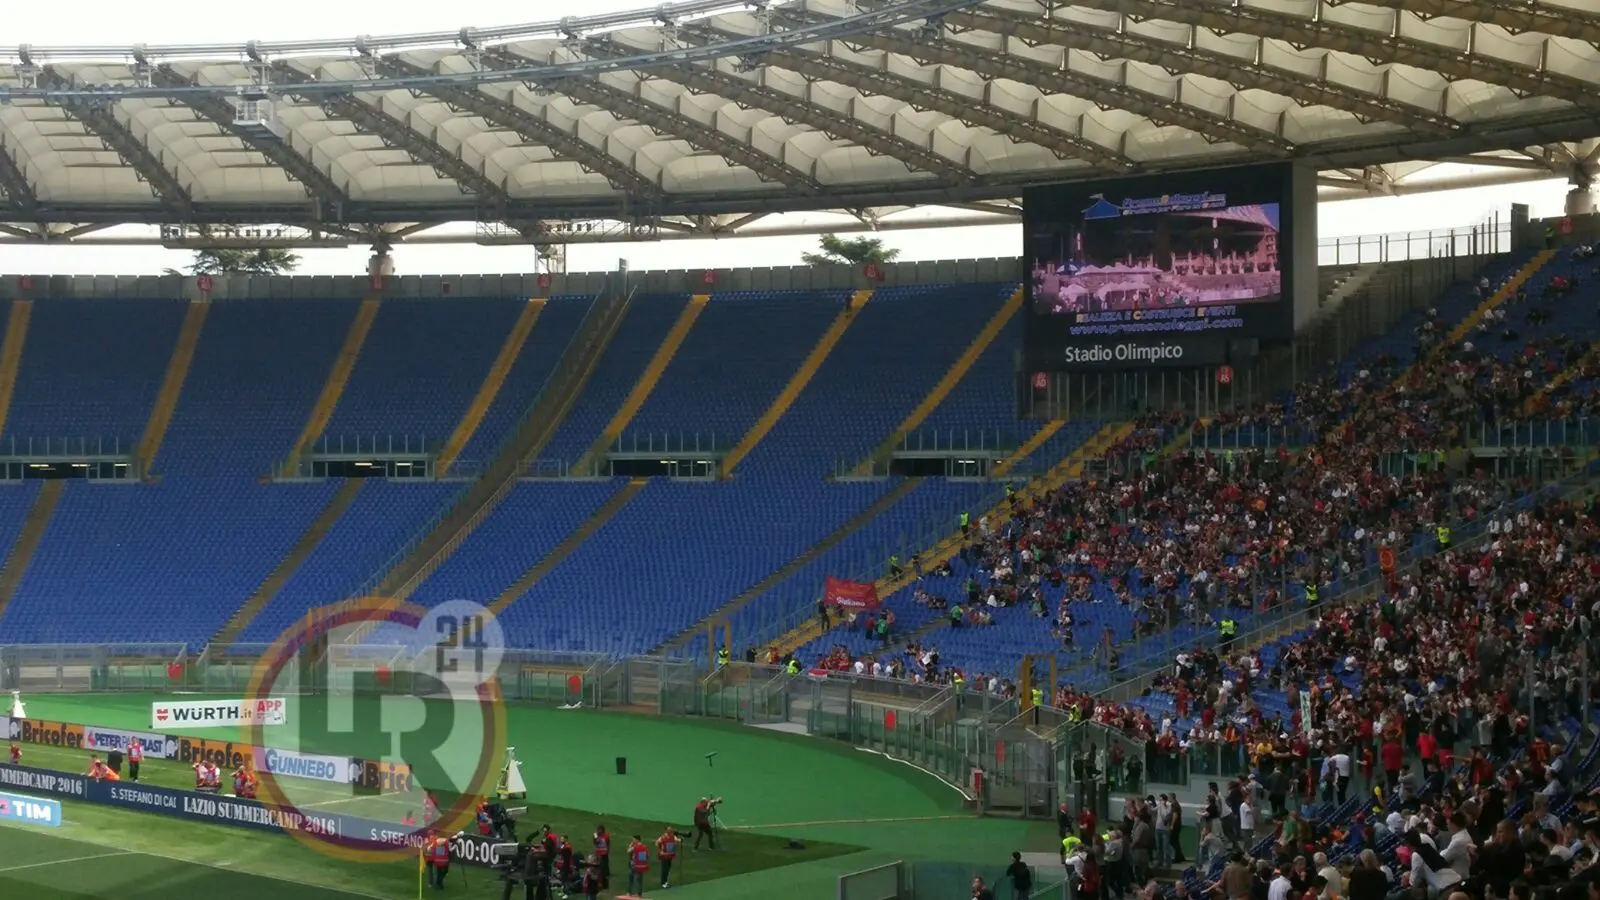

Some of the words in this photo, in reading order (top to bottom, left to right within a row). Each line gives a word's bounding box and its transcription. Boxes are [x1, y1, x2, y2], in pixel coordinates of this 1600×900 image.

[1065, 344, 1113, 363] Stadio
[1115, 342, 1183, 363] Olimpico
[257, 700, 282, 712] APP
[22, 720, 84, 749] Bricofer
[265, 748, 336, 780] GUNNEBO
[58, 776, 83, 795] 2016
[111, 787, 118, 799] S.
[119, 788, 153, 804] STEFANO
[154, 793, 163, 806] DI
[11, 800, 51, 822] TIM
[183, 796, 216, 816] LAZIO
[217, 802, 303, 830] SUMMERCAMP
[304, 815, 335, 836] 2016
[370, 828, 379, 841] S.
[380, 830, 423, 849] STEFANO
